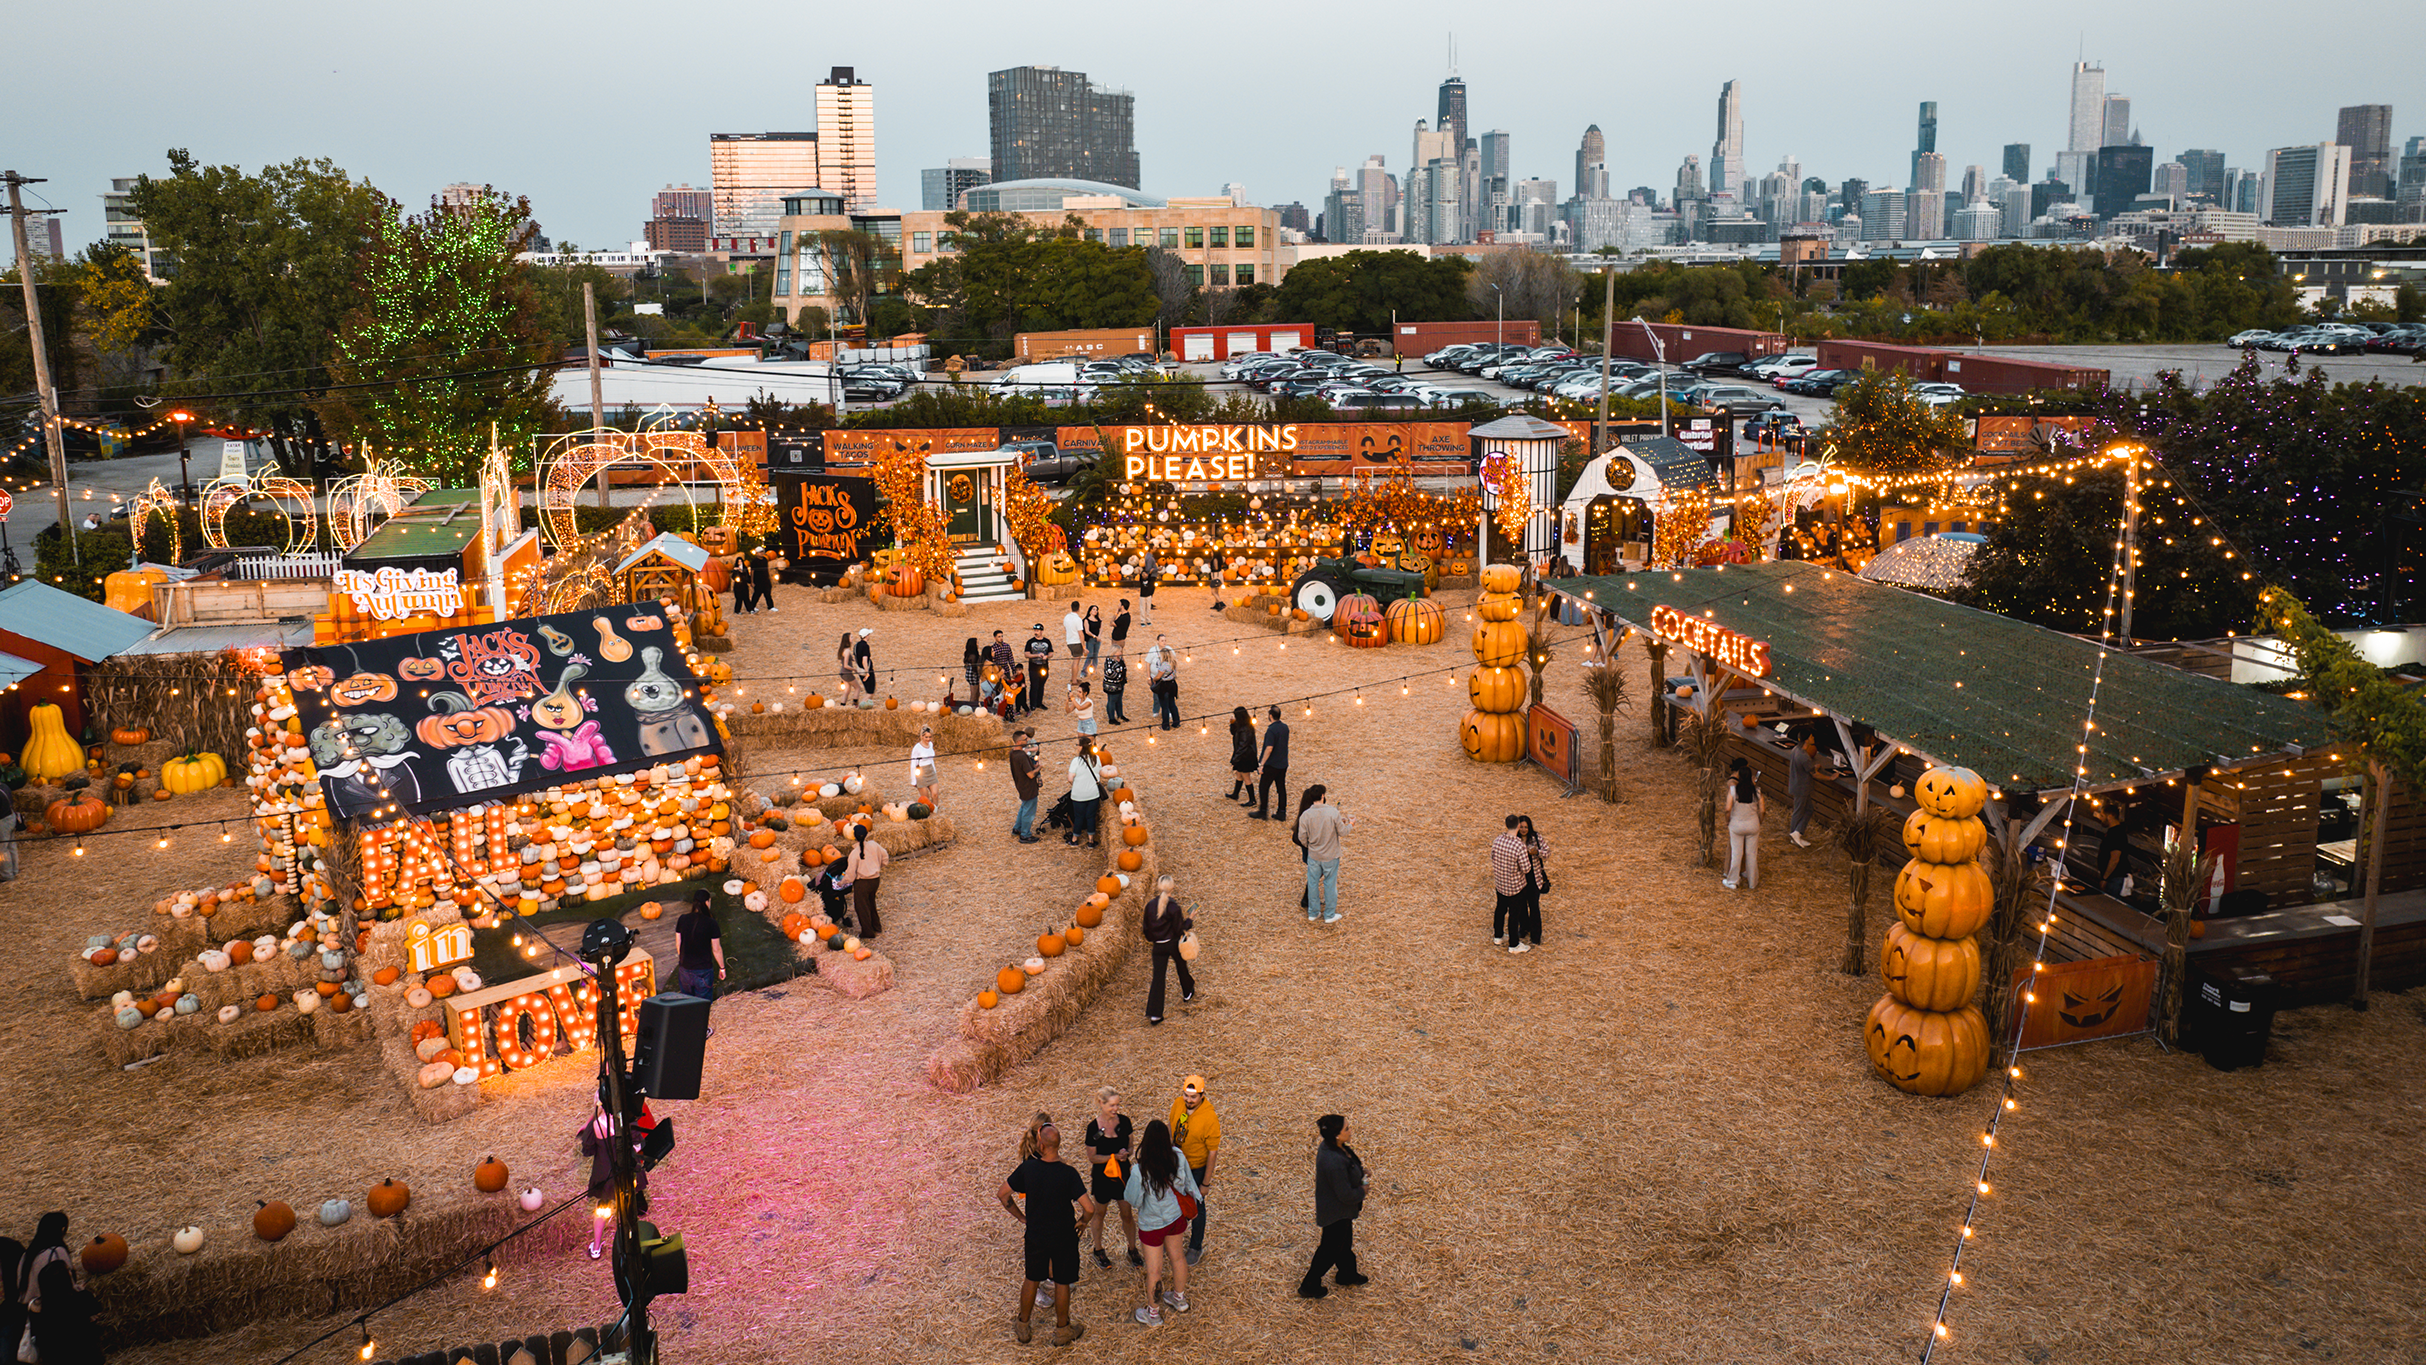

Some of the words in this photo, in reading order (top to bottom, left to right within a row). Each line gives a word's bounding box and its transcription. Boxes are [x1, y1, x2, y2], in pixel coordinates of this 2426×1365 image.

[833, 442, 874, 450] WALKING
[968, 441, 987, 449] MAZE
[1125, 425, 1298, 453] PUMPKINS
[1621, 434, 1638, 443] VALET
[1680, 431, 1713, 440] Gabriel
[1682, 441, 1714, 451] arking
[840, 451, 869, 459] TACOS
[1125, 452, 1256, 481] PLEASE!
[793, 526, 859, 560] PUMPKIN
[376, 570, 457, 592] Giving
[356, 593, 461, 619] Autumn
[447, 627, 541, 681] JACK'S
[1651, 605, 1772, 678] COCKTAILS
[454, 668, 553, 709] PUMPKIN
[360, 802, 521, 903] FALL
[412, 922, 475, 973] in
[459, 963, 651, 1079] LOVE
